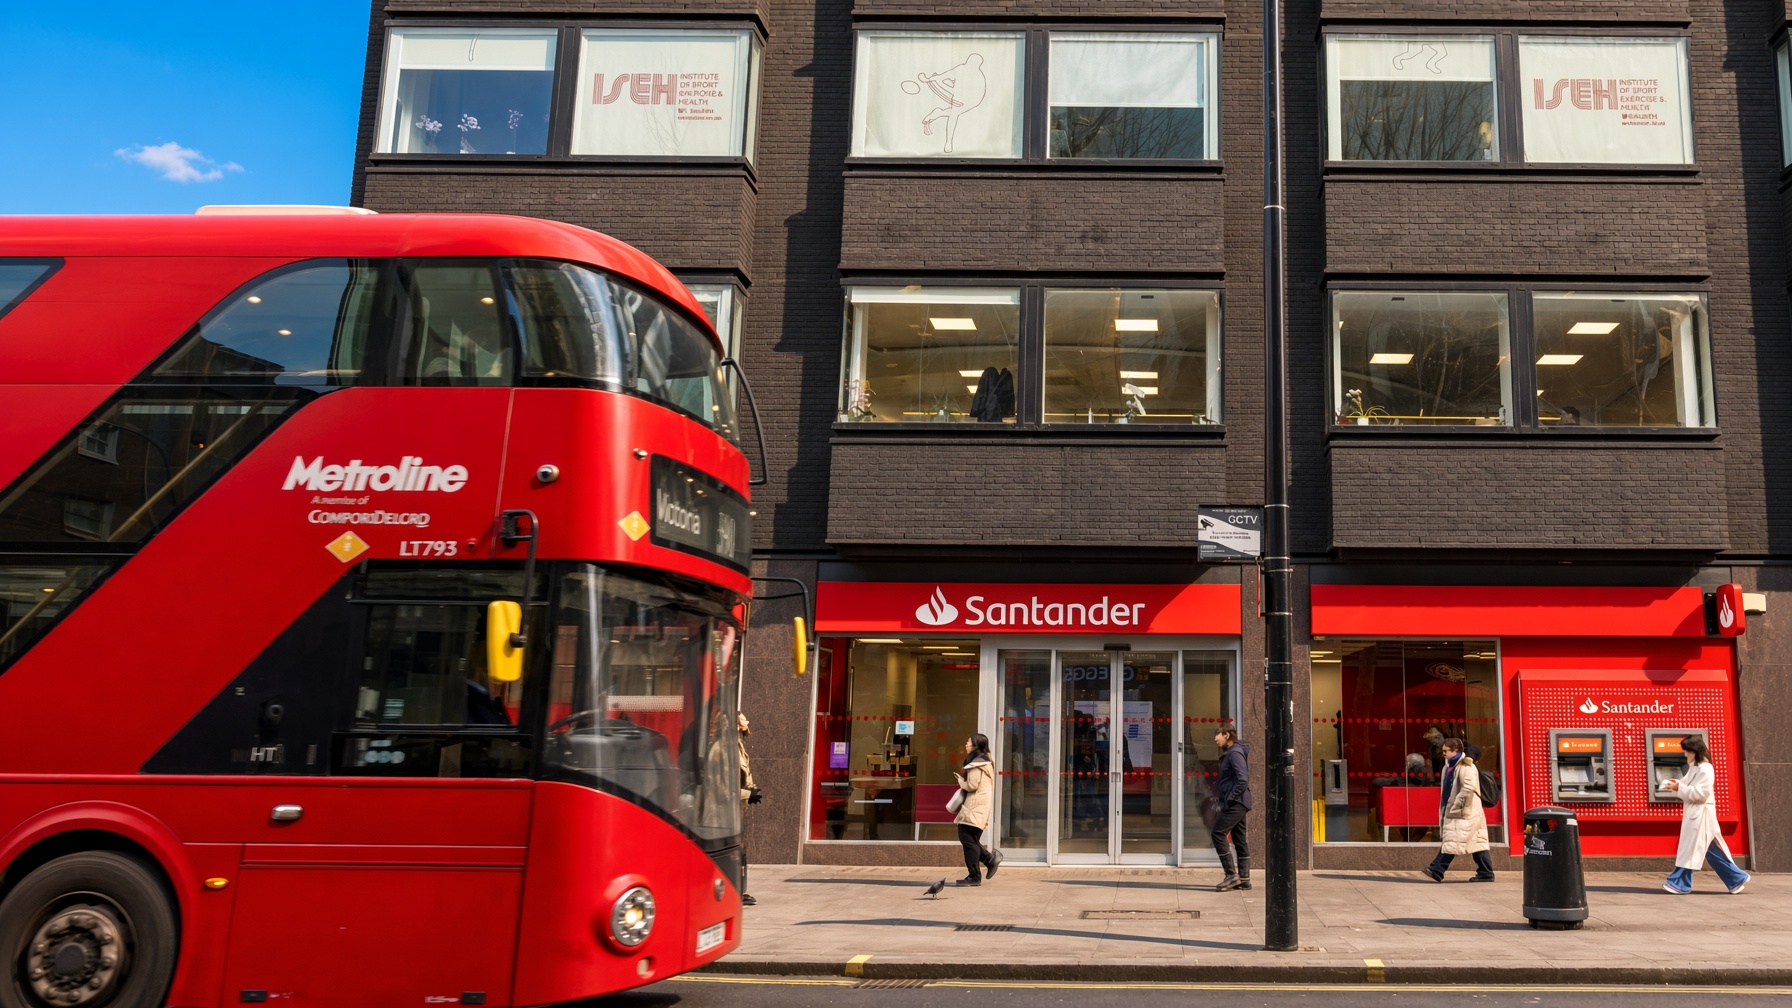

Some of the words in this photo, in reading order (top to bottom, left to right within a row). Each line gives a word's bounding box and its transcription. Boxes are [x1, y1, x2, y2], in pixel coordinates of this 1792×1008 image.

[592, 73, 678, 105] ISEH
[1534, 79, 1618, 110] ISEH
[281, 456, 469, 492] Metroline
[399, 541, 457, 556] LT793
[965, 596, 1145, 625] Santander
[1601, 699, 1675, 714] Santander
